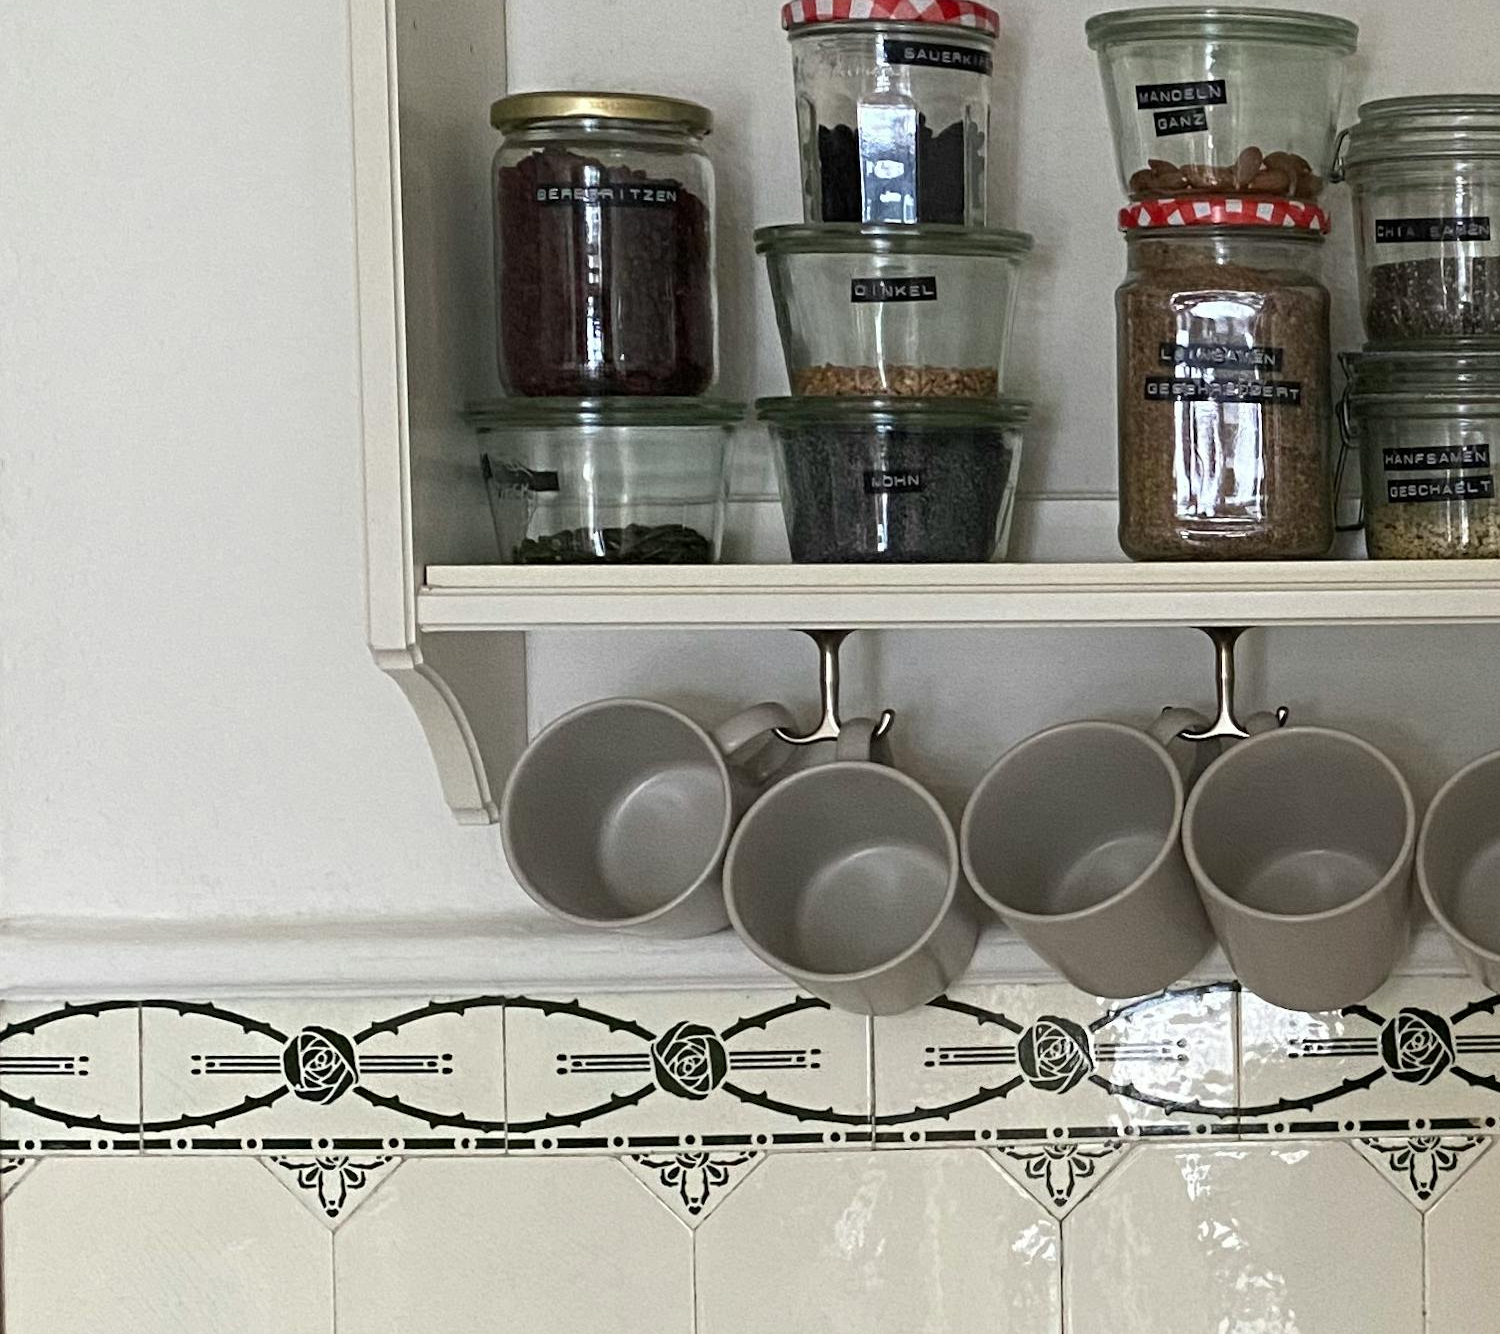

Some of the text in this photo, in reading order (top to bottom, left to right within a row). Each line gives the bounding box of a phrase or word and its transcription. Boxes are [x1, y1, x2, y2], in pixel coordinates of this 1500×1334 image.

[1138, 84, 1222, 104] MANDELN
[1157, 112, 1205, 131] GANZ
[1377, 225, 1416, 238] CHIA
[854, 284, 935, 298] DINKEL
[1384, 450, 1487, 466] HANFSAMEN
[1389, 480, 1492, 499] GESCHAELT
